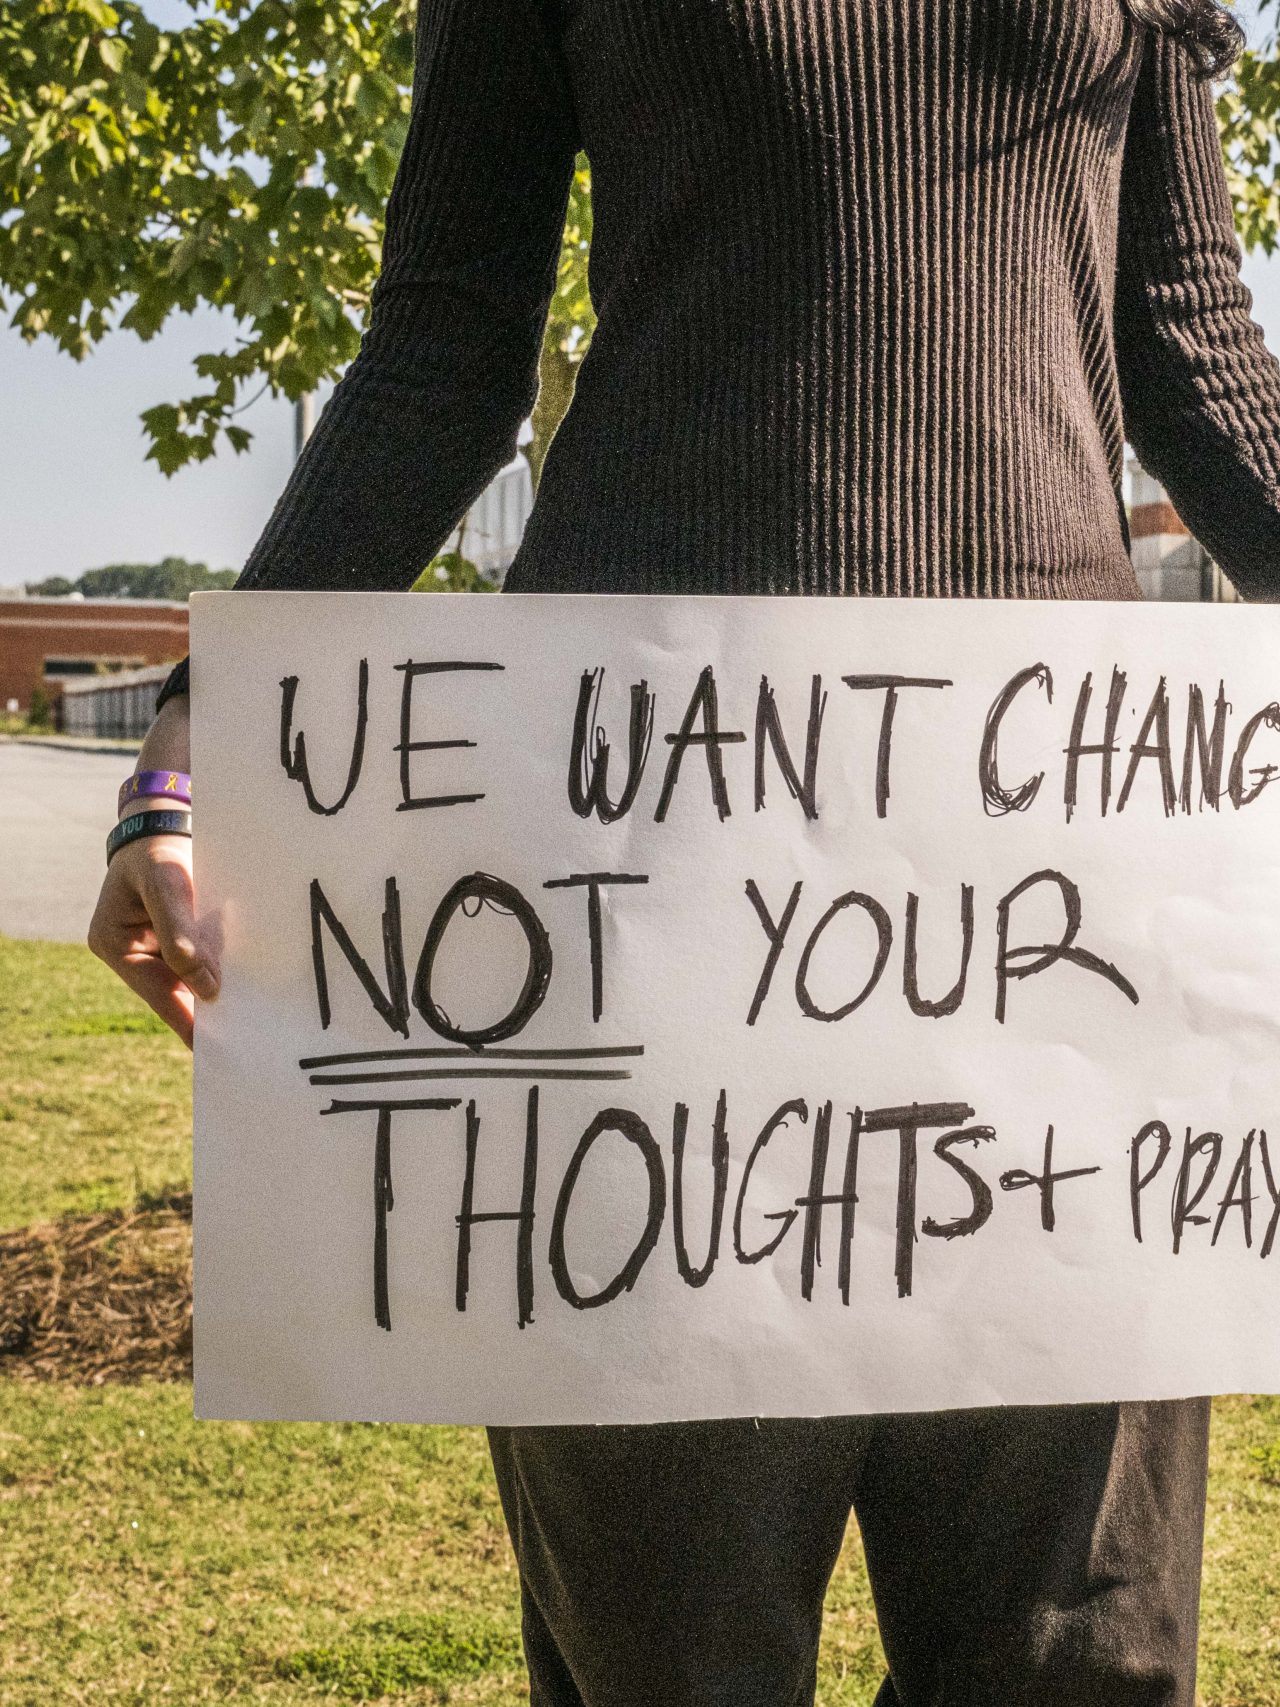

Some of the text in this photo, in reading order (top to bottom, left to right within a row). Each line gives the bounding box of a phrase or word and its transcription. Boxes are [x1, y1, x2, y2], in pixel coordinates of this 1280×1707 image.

[121, 815, 144, 837] YOU
[279, 658, 505, 816] WE
[568, 665, 953, 824] WANT
[309, 868, 1139, 1052] NOT YOUR
[320, 1085, 997, 1331] THOUGHTS
